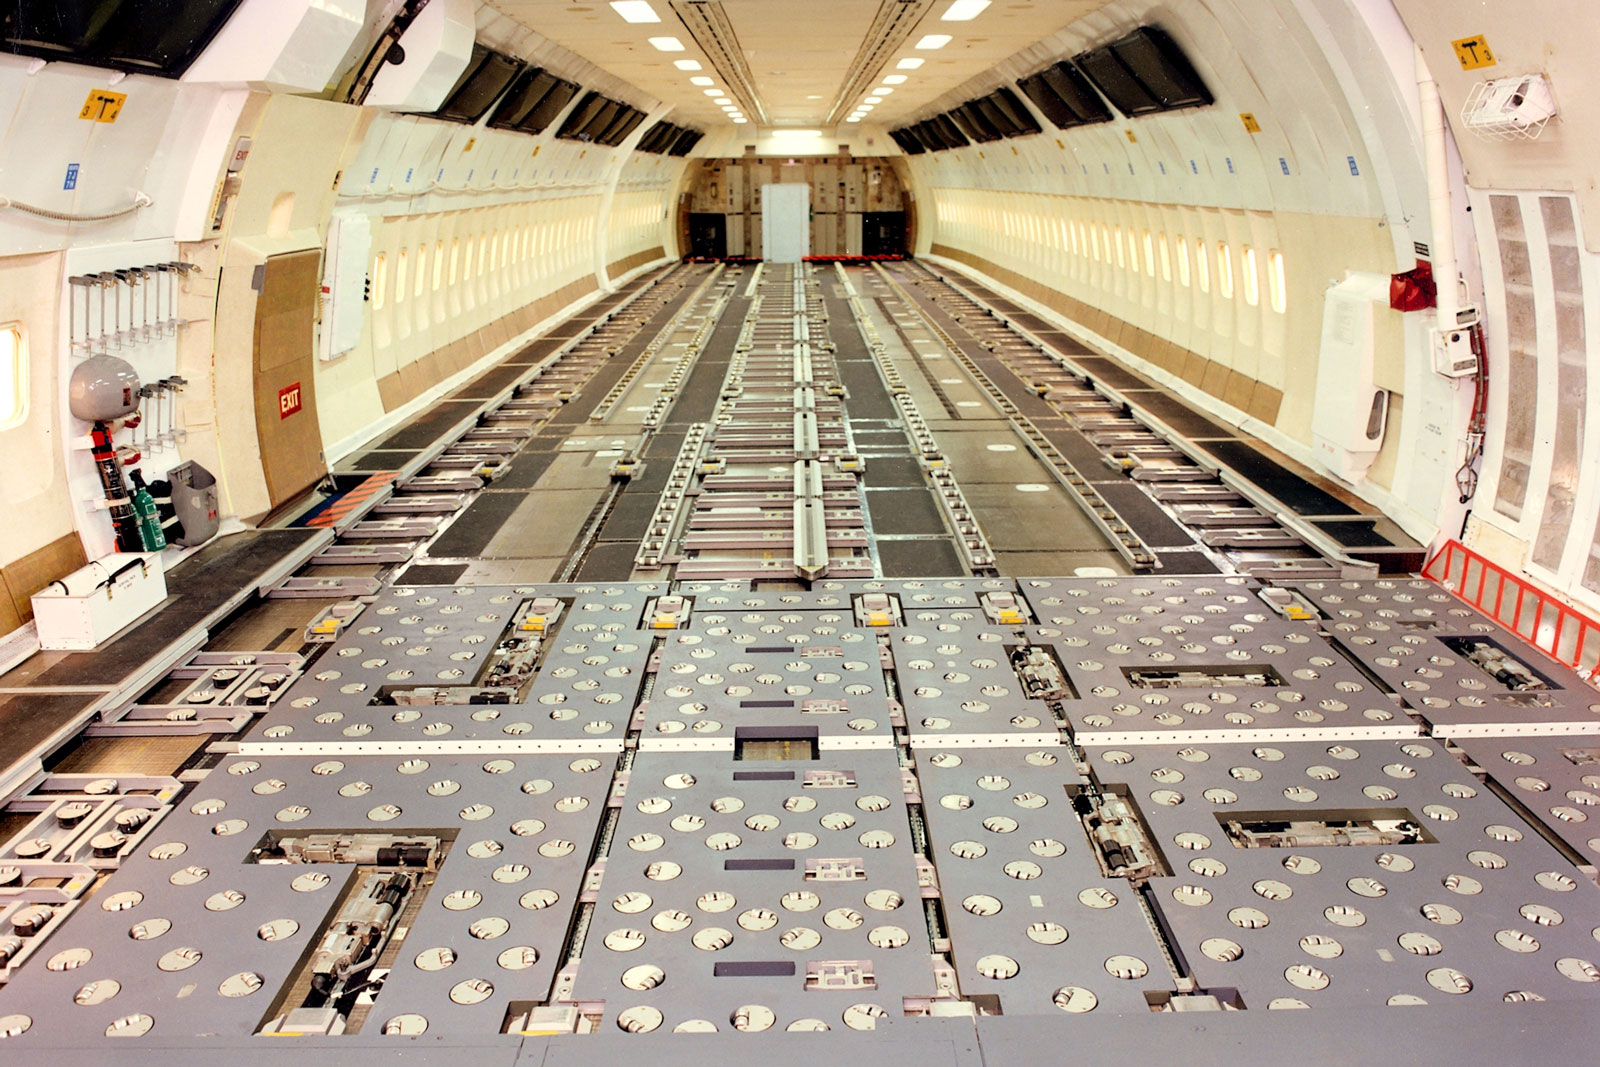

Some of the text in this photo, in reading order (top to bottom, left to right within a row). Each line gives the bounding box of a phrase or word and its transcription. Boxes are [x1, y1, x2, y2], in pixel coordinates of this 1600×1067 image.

[1460, 49, 1492, 65] 4 3
[82, 105, 90, 117] 3
[235, 150, 249, 161] EXIT
[280, 388, 299, 413] EXIT
